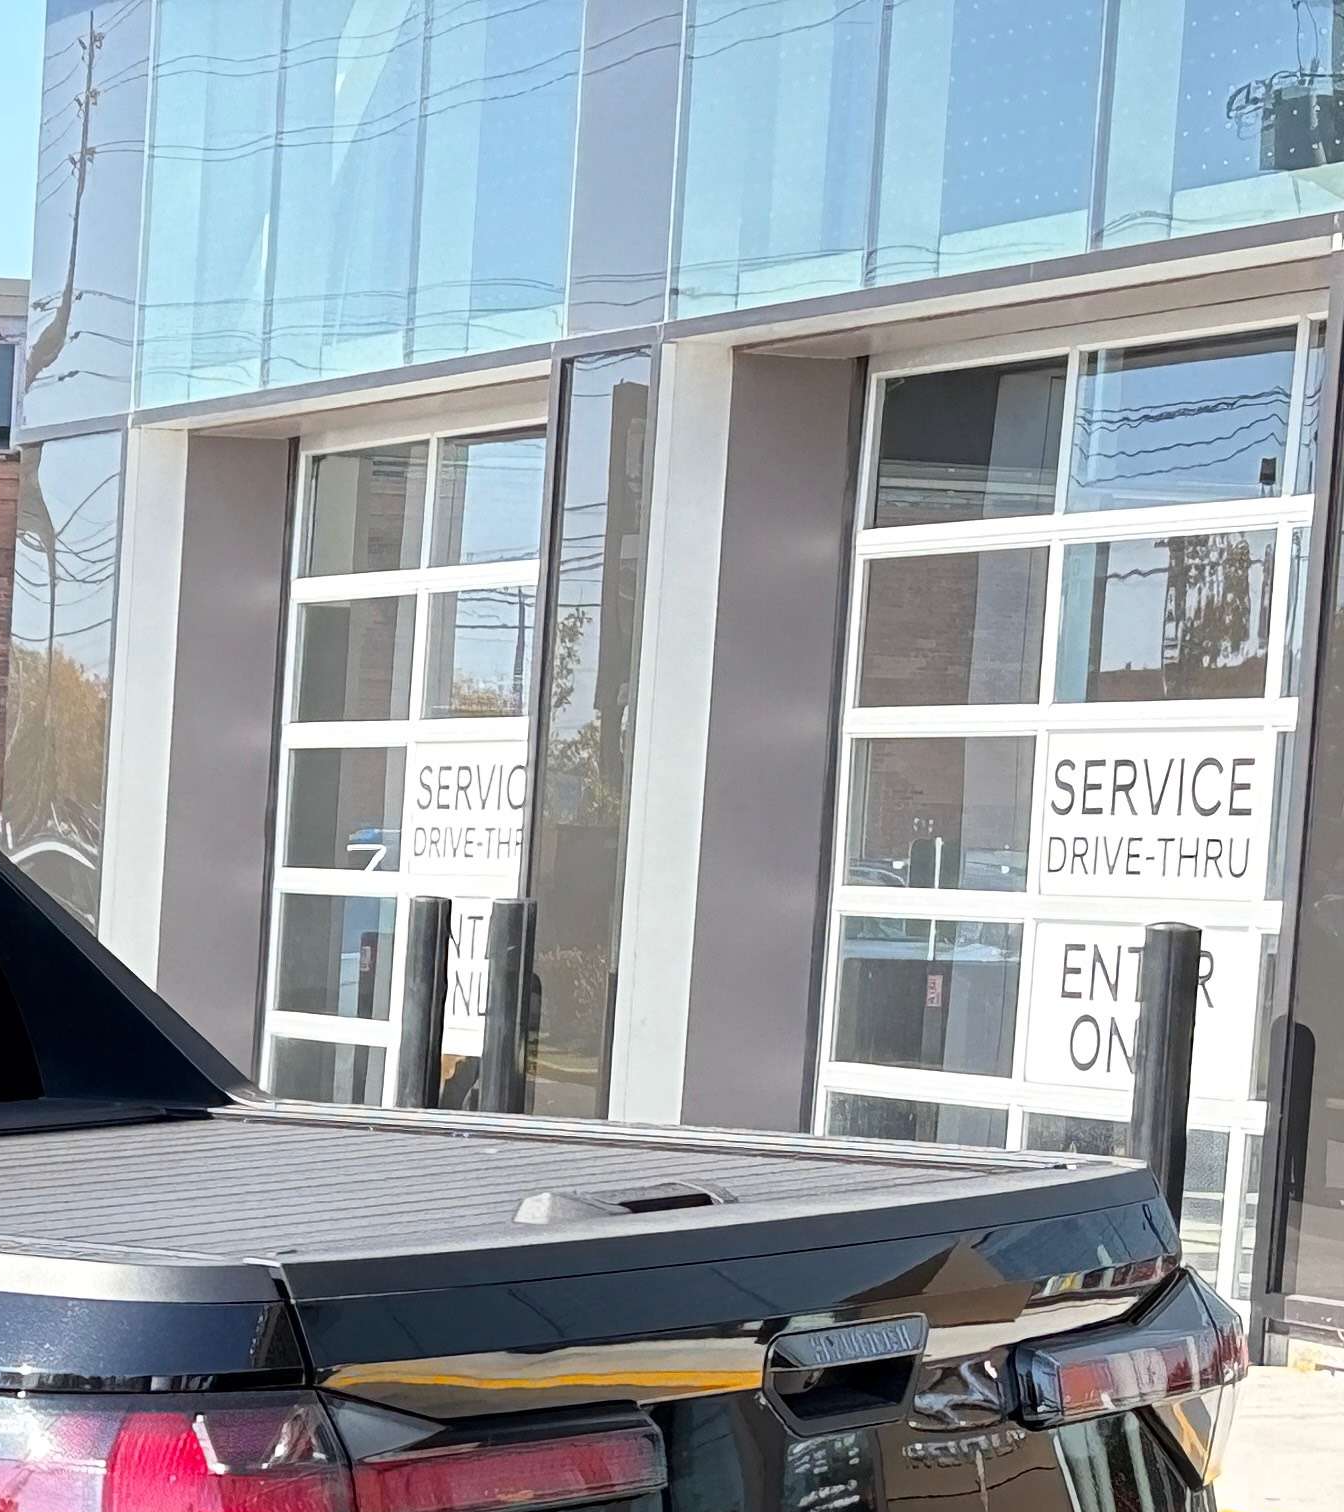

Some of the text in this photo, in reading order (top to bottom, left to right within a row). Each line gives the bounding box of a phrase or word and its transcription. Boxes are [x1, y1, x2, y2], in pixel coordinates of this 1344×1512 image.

[417, 764, 527, 811] SERVIC
[1051, 757, 1256, 816] SERVICE
[1047, 836, 1251, 879] DRIVE-THRU
[1061, 943, 1214, 1009] ENTR
[1069, 1014, 1140, 1074] ON
